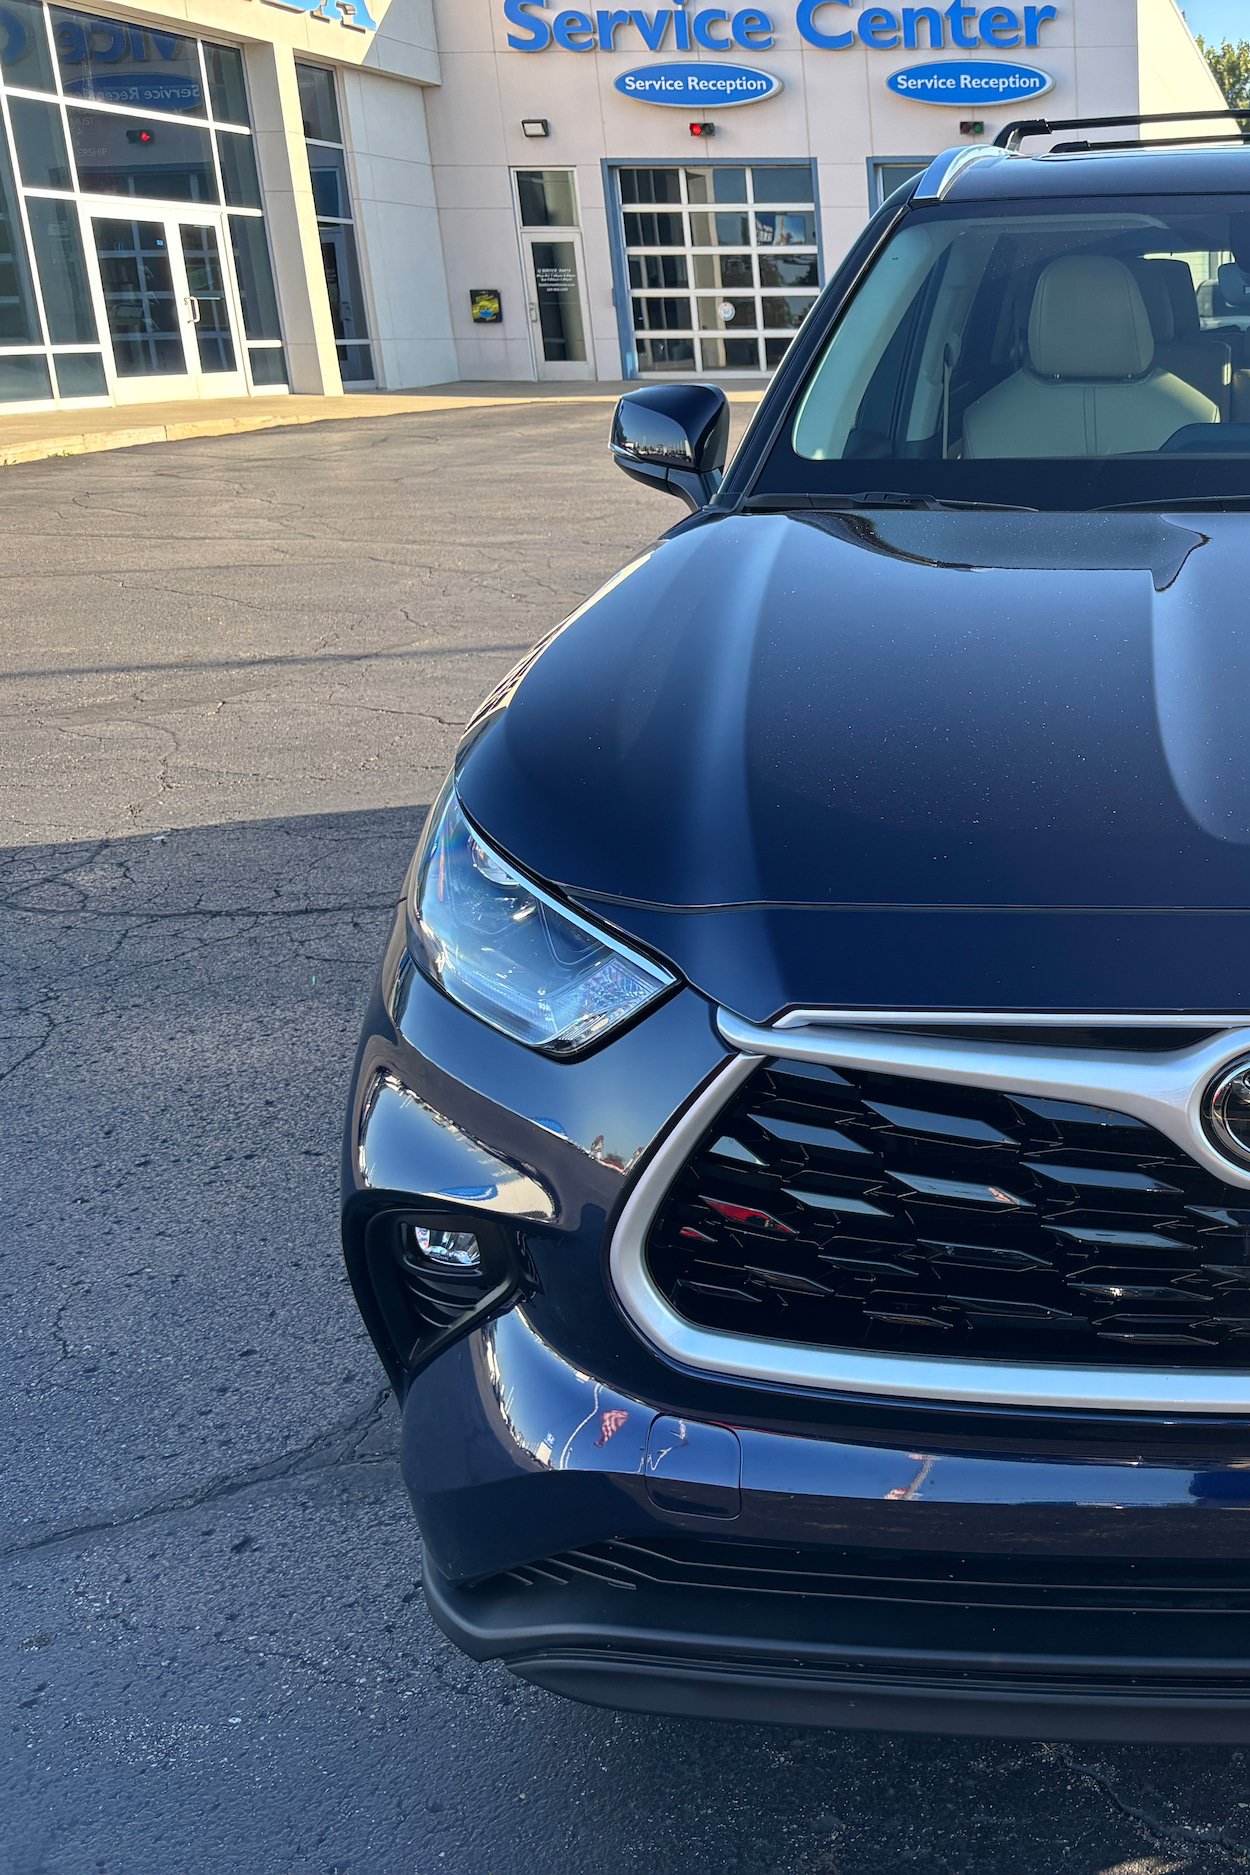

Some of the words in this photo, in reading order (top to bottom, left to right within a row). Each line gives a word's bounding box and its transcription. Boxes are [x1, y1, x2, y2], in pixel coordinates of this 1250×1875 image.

[504, 0, 777, 52] Service
[796, 0, 1056, 49] Center
[625, 76, 684, 91] Service
[688, 76, 767, 94] Reception
[897, 75, 956, 90] Service
[960, 73, 1040, 92] Reception
